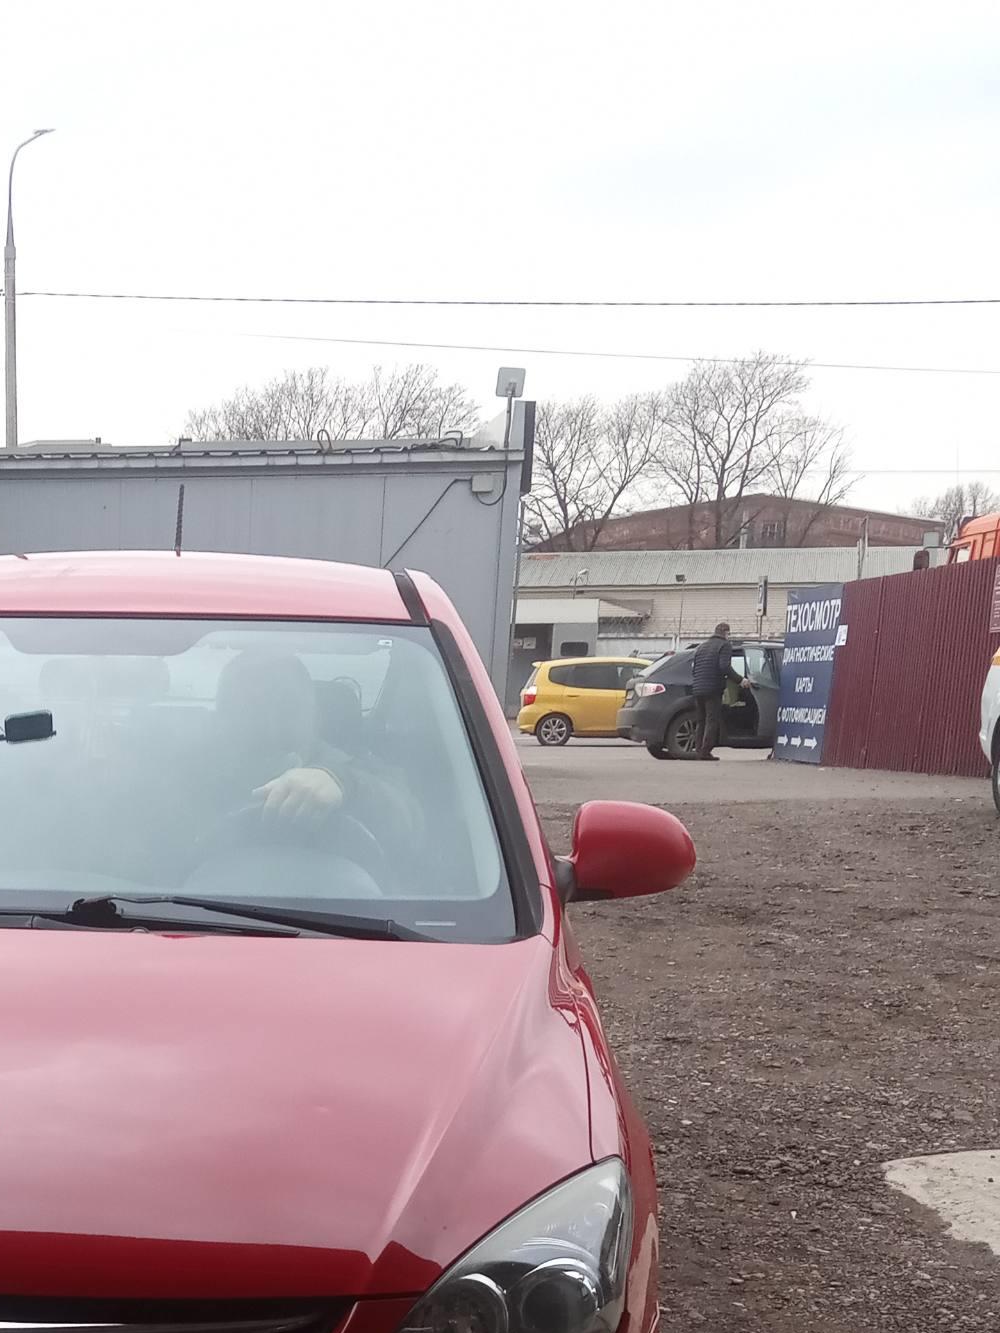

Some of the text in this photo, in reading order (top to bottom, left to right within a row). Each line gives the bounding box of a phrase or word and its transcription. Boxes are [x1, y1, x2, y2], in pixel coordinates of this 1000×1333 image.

[786, 598, 841, 633] ТЕХОСМОТР
[782, 645, 836, 666] ДИАГНОСТИЧЕСКИЕ
[795, 676, 814, 693] КАРТЫ
[781, 704, 827, 727] ФОТОФИКСАЦИЕЙ
